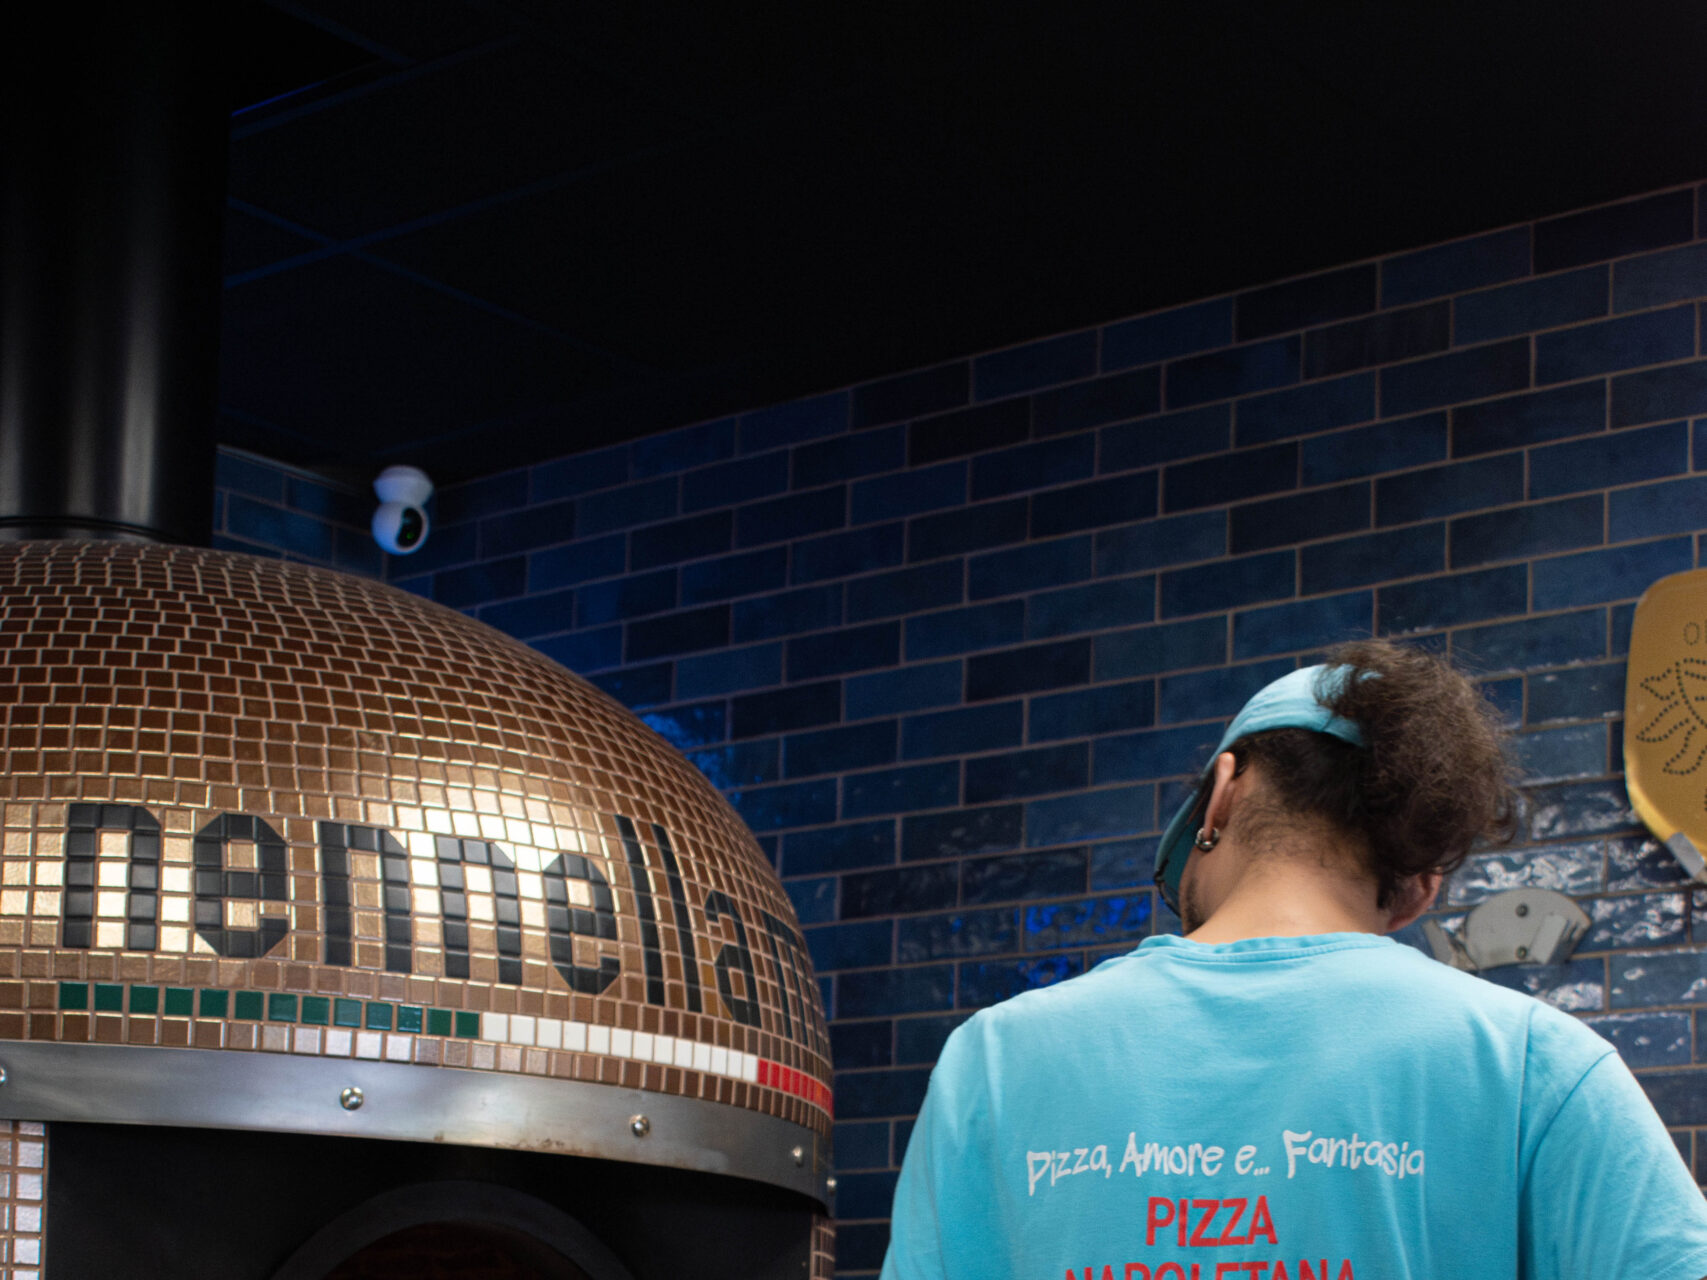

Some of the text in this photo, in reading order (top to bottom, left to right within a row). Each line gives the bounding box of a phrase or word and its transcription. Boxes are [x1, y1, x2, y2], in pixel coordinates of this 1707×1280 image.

[1026, 1144, 1112, 1196] Pizza,
[1119, 1131, 1225, 1177] Amore
[1283, 1129, 1425, 1179] Fantasia
[1145, 1195, 1278, 1248] PIZZA
